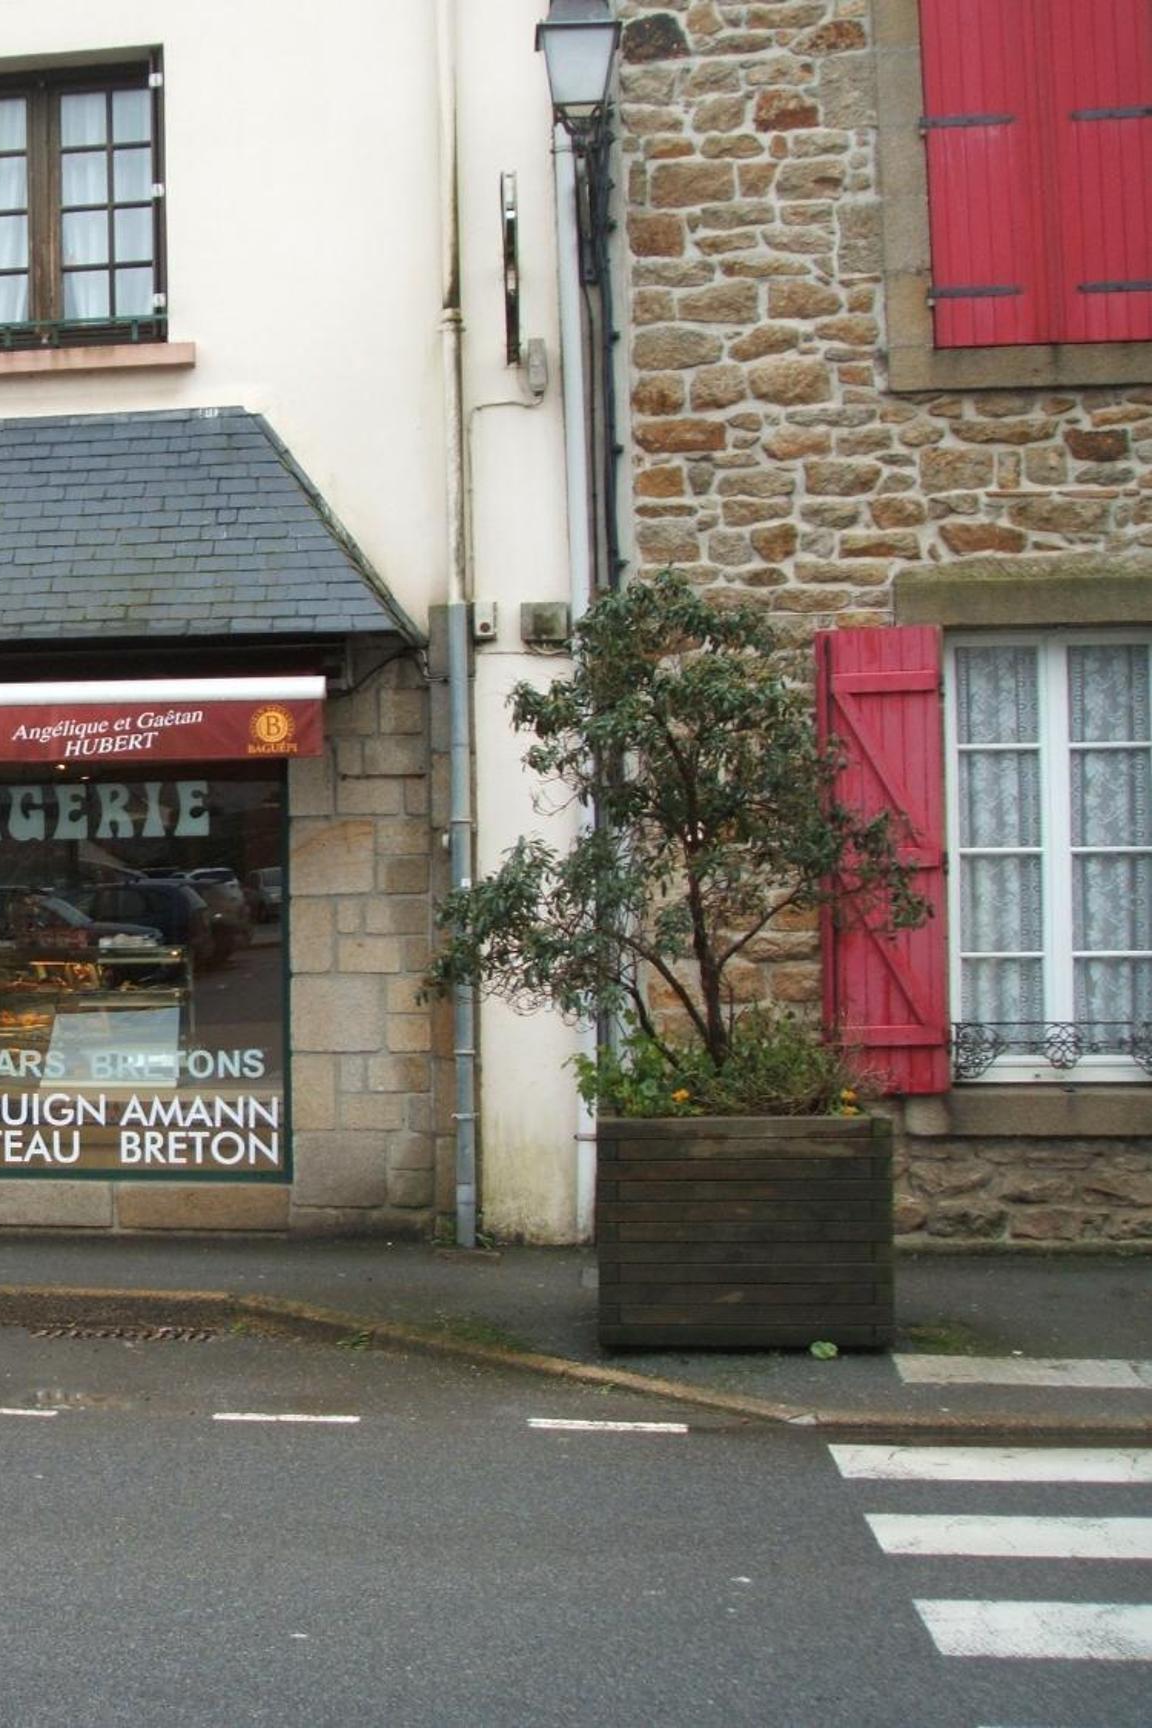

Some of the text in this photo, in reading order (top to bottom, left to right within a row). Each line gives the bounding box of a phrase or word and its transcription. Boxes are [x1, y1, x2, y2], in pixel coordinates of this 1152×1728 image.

[12, 719, 109, 743] Angélique
[114, 717, 131, 731] et
[64, 732, 158, 757] HUBERT
[90, 1048, 265, 1079] BRETONS
[120, 1094, 279, 1128] AMANN
[120, 1131, 279, 1165] BRETON
